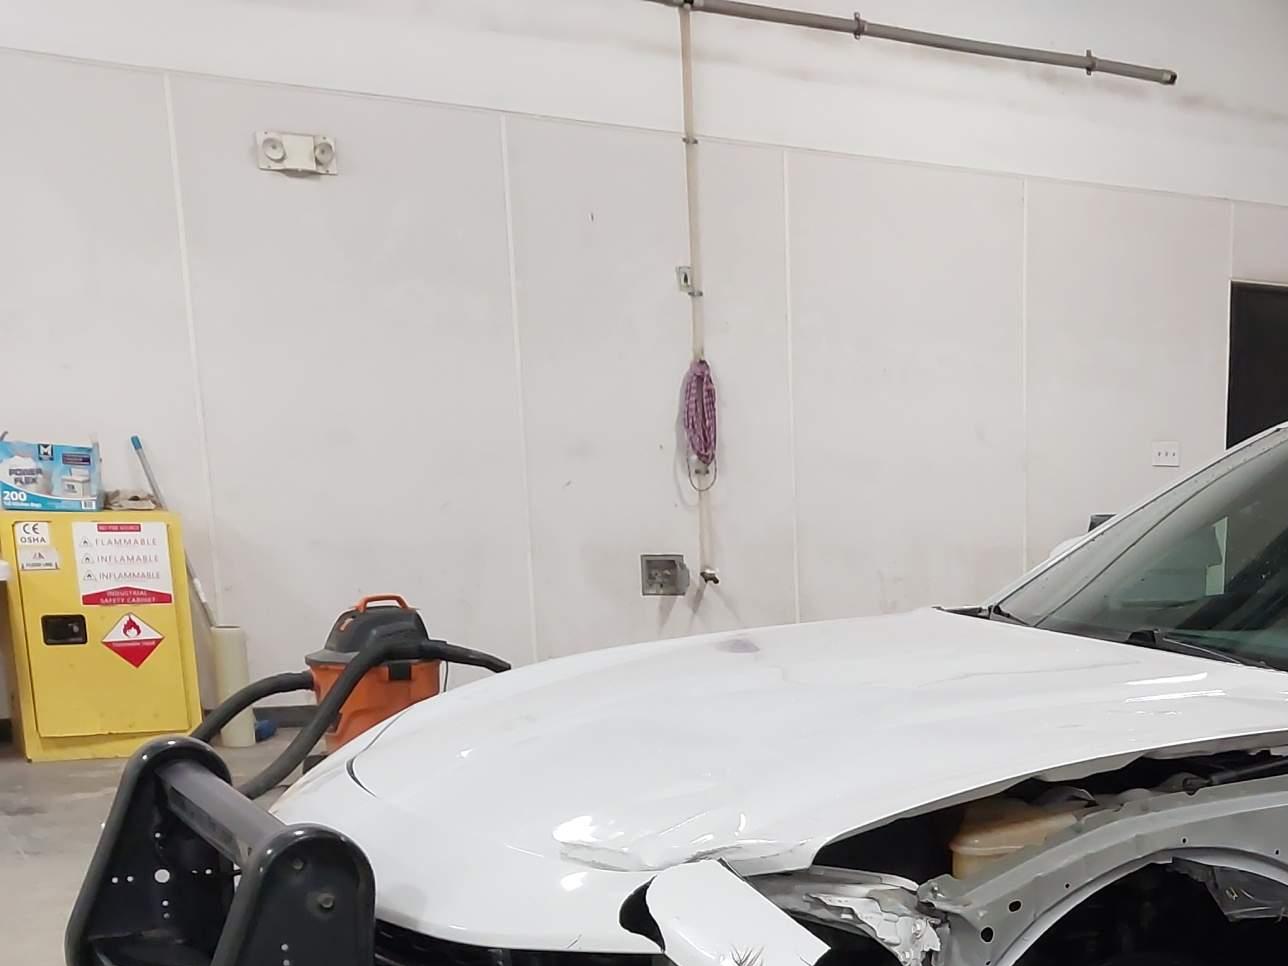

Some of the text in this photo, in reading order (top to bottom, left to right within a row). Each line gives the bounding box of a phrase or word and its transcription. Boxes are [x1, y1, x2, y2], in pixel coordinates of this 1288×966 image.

[3, 490, 27, 501] 200
[20, 536, 47, 544] OSHA
[95, 537, 158, 546] FLAMMABLE
[97, 554, 159, 563] INFLAMABLE
[99, 570, 160, 580] INFLAMMABLE
[106, 589, 147, 597] INDUSTRIAL
